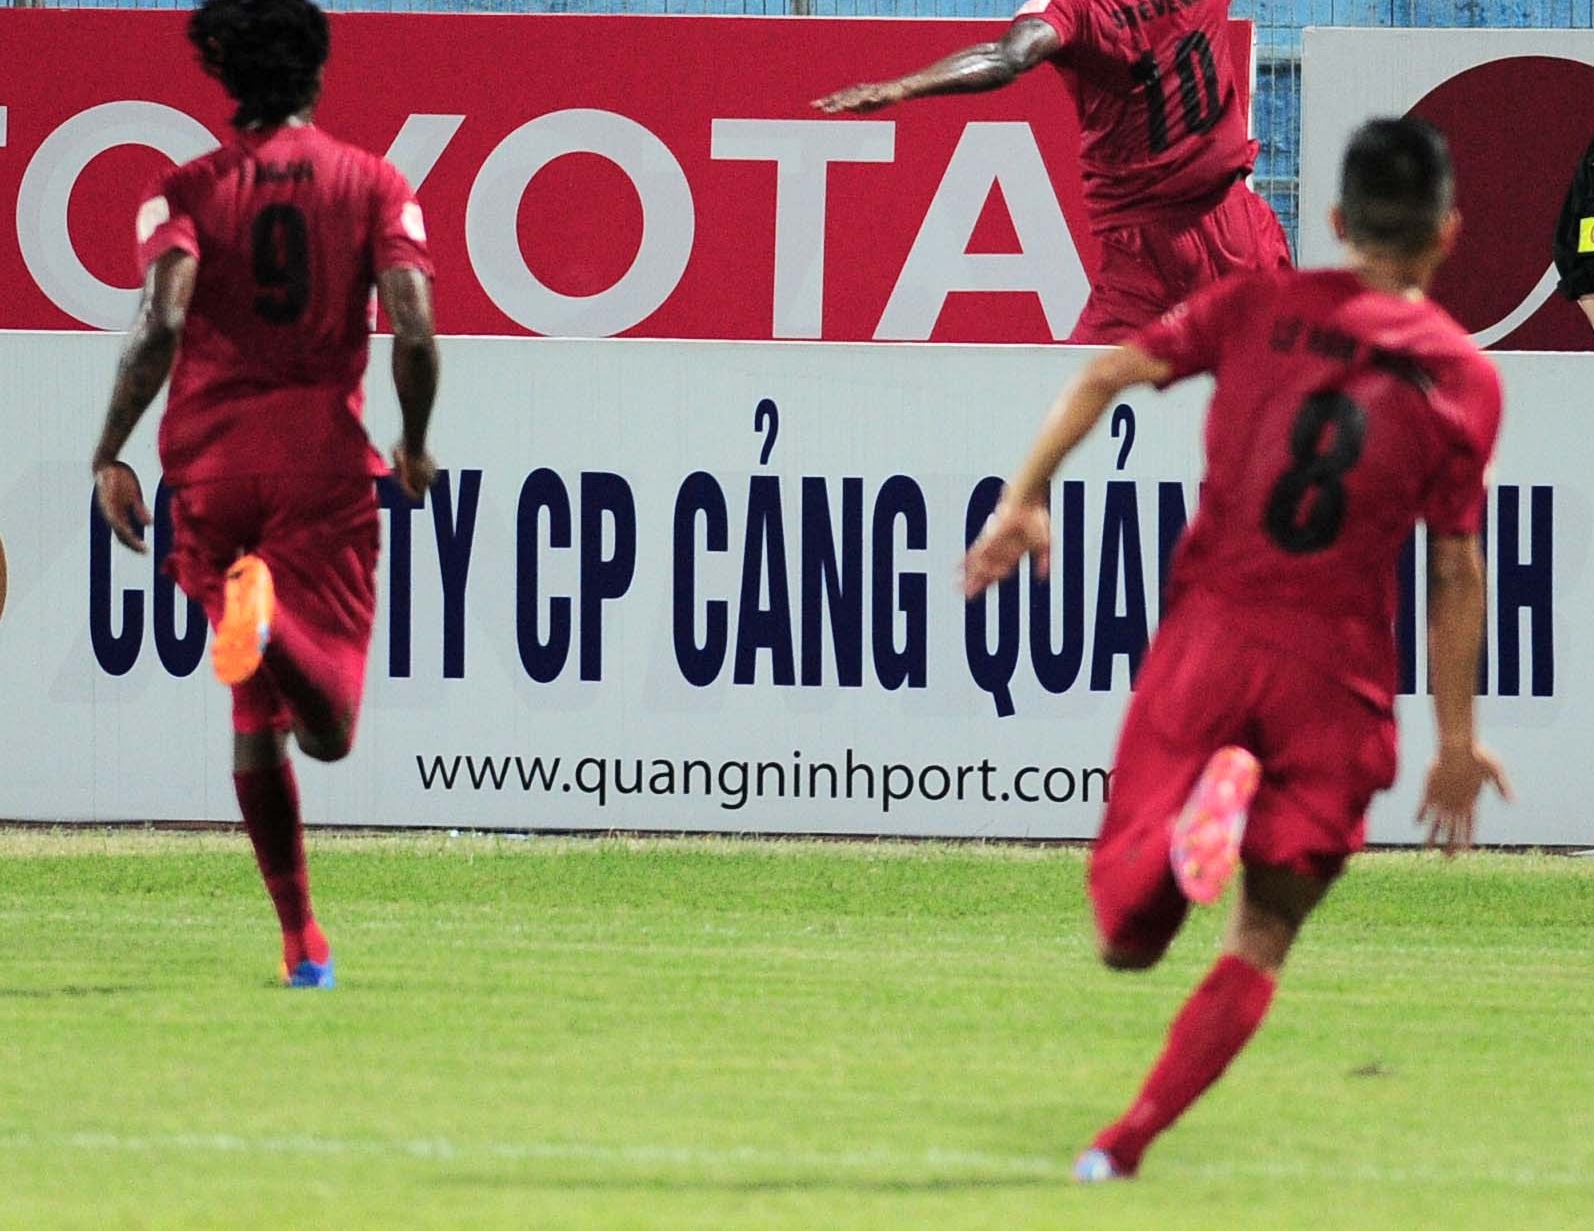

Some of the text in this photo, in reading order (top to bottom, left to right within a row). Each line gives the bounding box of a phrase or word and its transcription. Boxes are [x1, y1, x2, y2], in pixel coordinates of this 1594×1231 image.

[1130, 30, 1224, 154] 10
[253, 203, 308, 325] 9
[1265, 391, 1366, 551] 8
[517, 467, 636, 684] CP
[673, 398, 927, 691] CẢNG
[416, 748, 1113, 812] www.quangninhport.com
